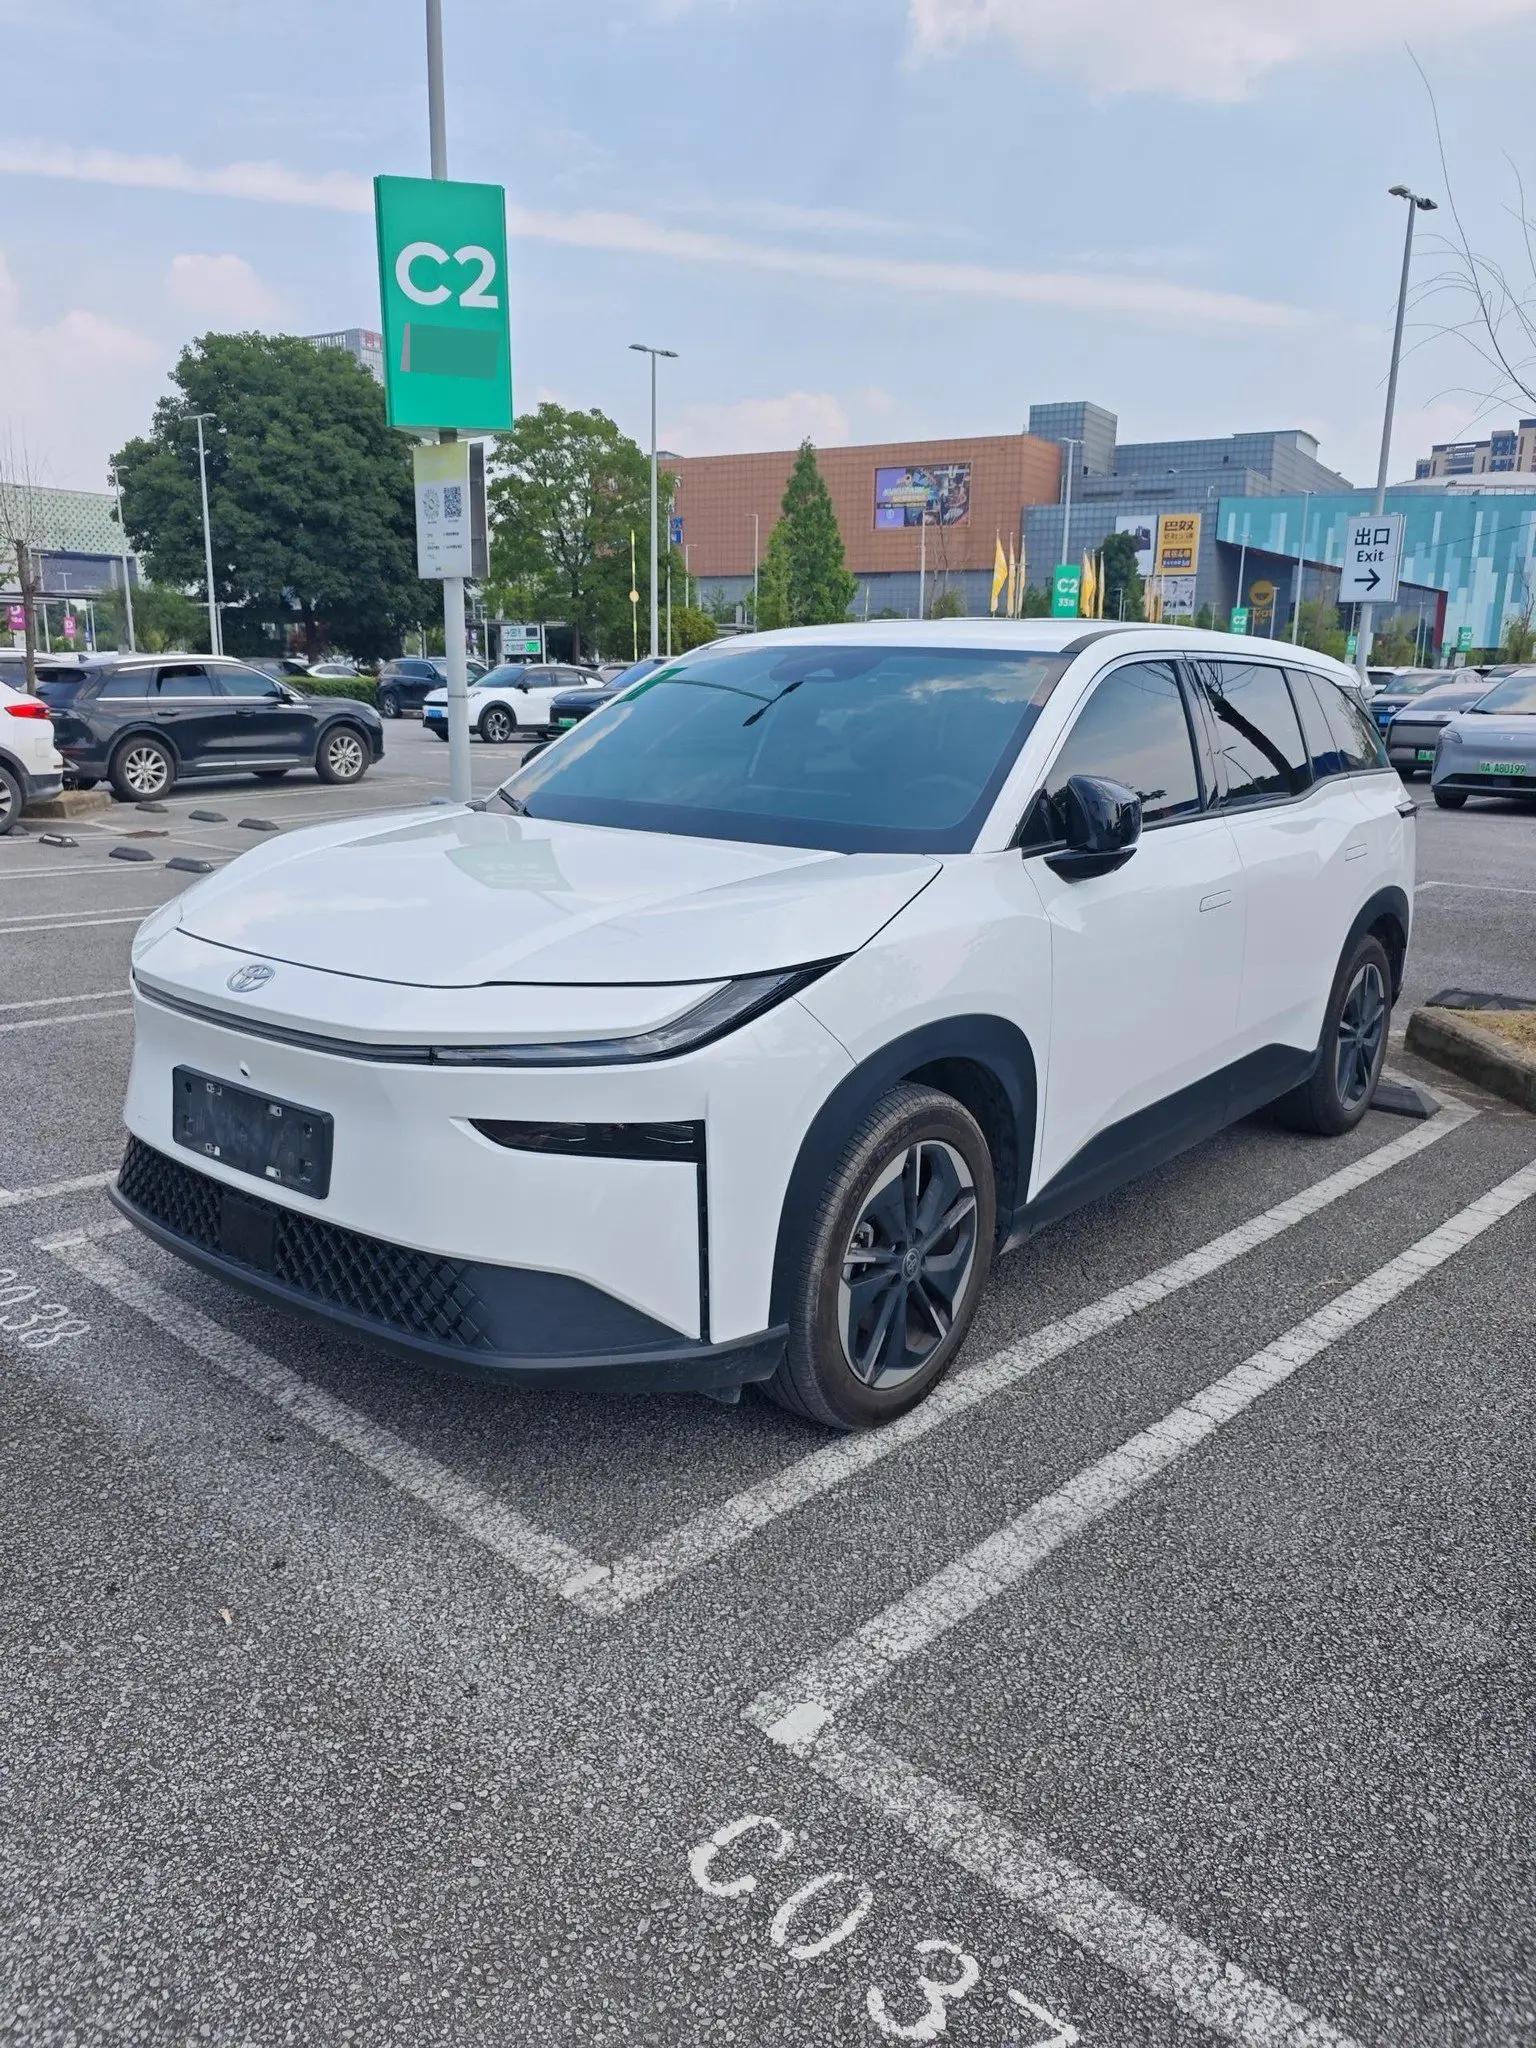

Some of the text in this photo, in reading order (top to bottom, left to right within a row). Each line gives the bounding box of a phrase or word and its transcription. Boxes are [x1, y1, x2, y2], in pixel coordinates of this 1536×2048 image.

[395, 241, 499, 309] C2
[1354, 527, 1391, 546] 出口
[1356, 549, 1385, 562] Exit
[1057, 577, 1079, 594] C2
